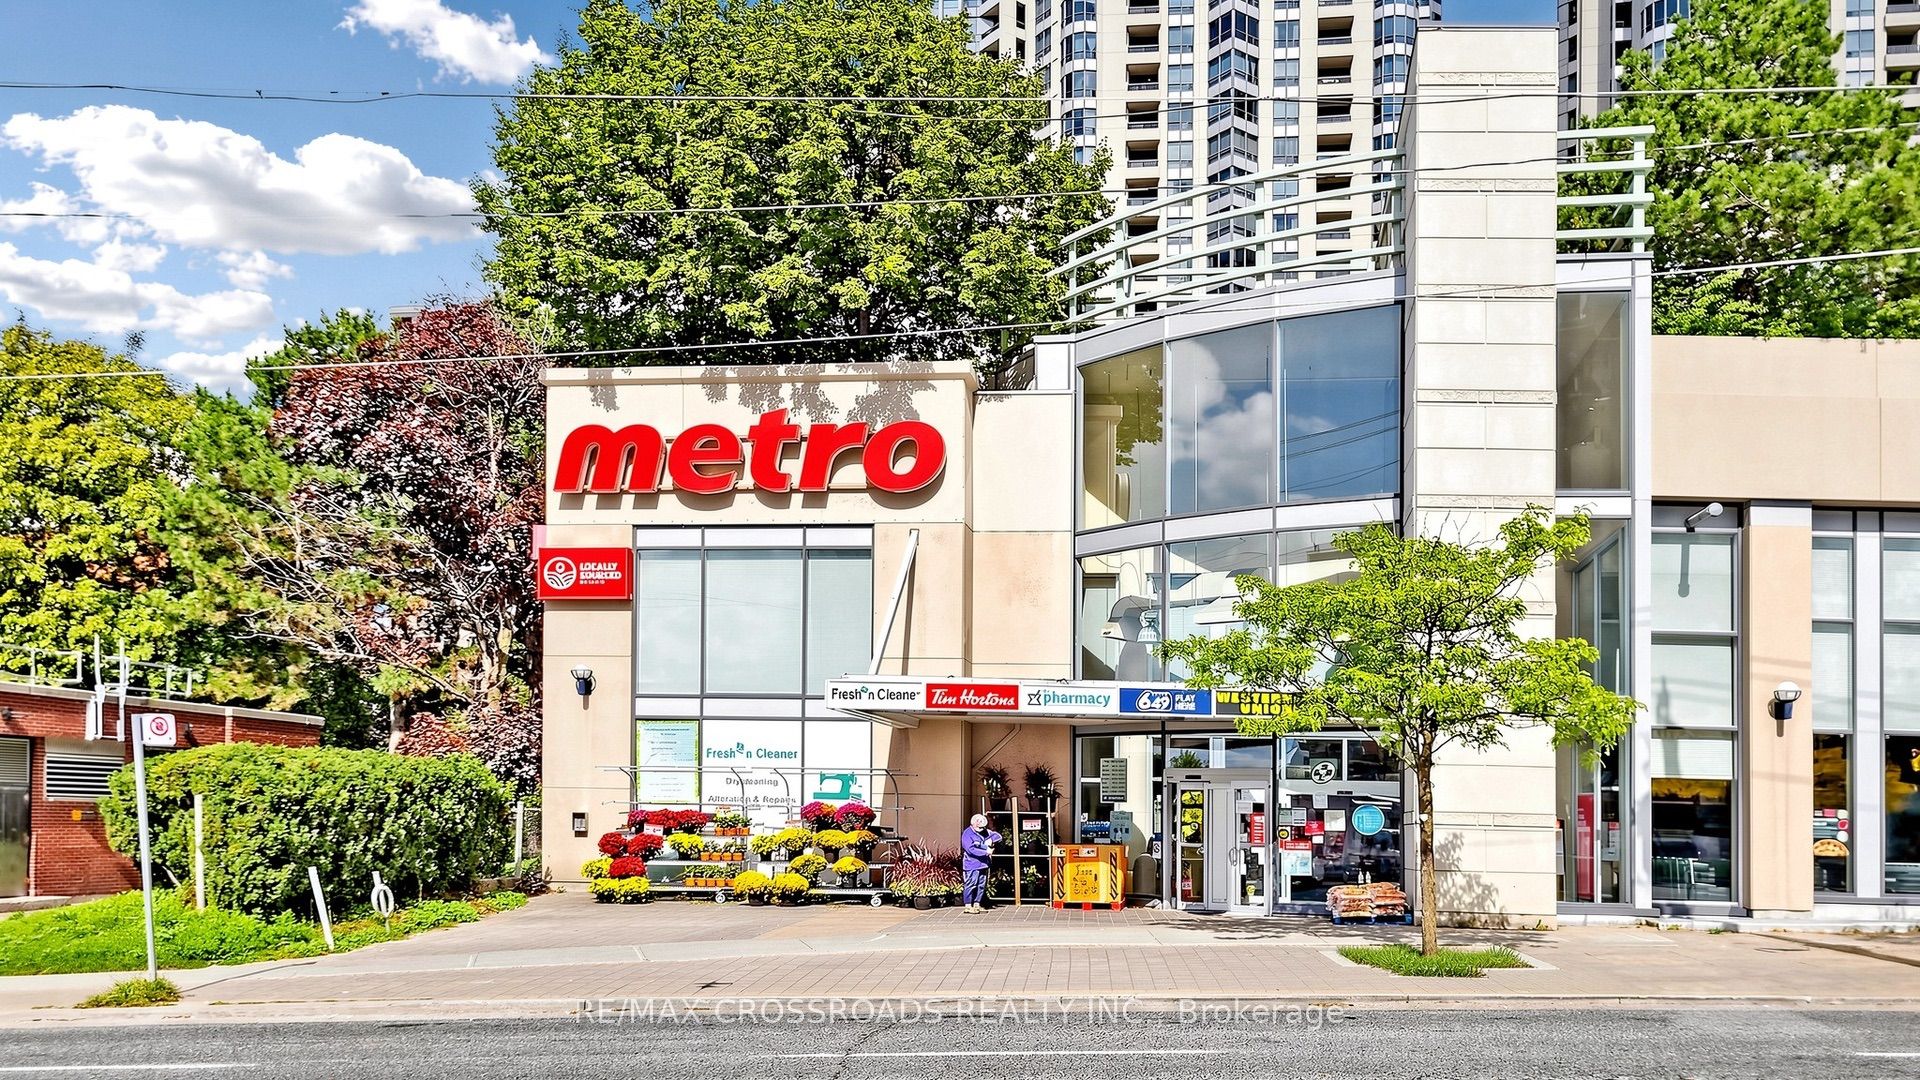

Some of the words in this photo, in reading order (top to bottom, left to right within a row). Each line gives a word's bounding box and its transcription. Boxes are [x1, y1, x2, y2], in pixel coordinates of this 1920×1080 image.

[553, 408, 948, 494] metro
[579, 562, 618, 571] LOCALLY
[931, 688, 957, 705] Tim
[959, 688, 1015, 706] Hortons
[1043, 690, 1111, 708] pharmacy
[706, 748, 736, 759] Fresh
[756, 748, 798, 759] Cleaner
